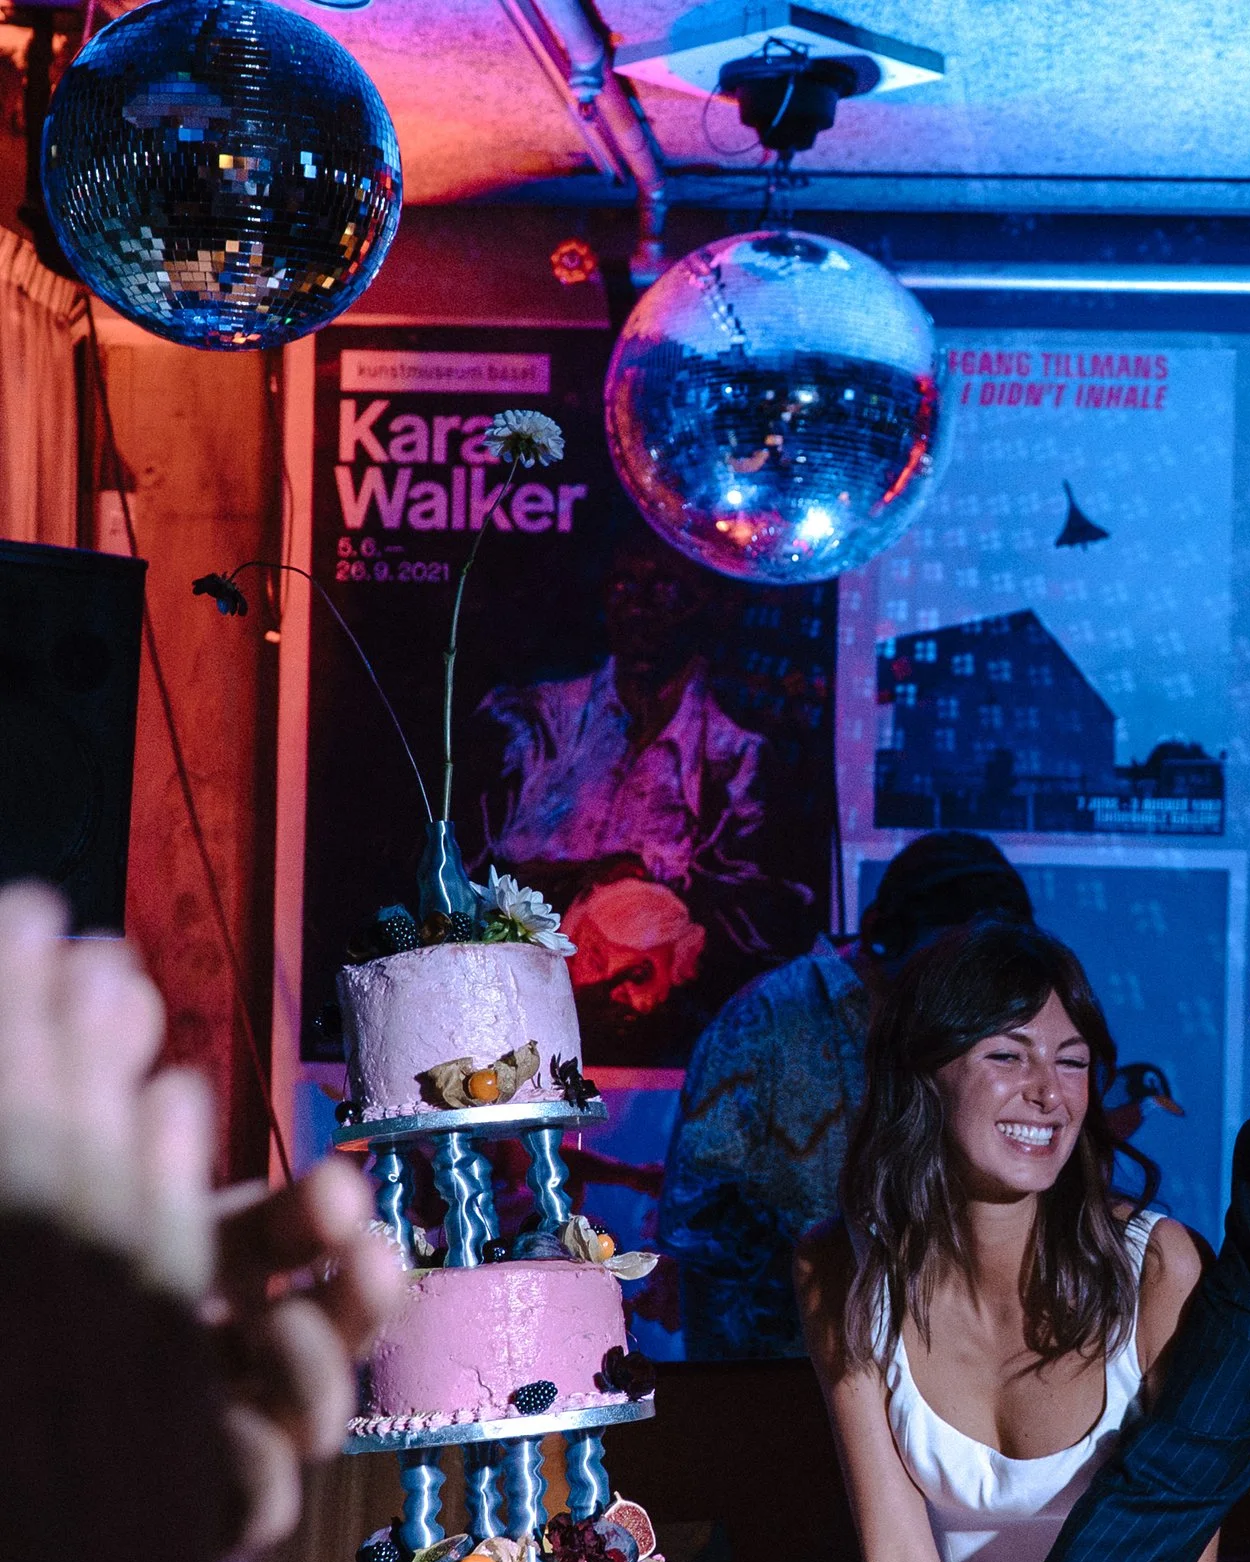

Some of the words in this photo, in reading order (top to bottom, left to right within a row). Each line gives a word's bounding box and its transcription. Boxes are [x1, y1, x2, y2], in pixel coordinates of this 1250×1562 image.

[1041, 352, 1169, 380] TILLMANS
[961, 382, 971, 405] I
[979, 382, 1067, 408] DIDN'T
[1075, 384, 1169, 411] INHALE
[339, 399, 501, 465] Kara
[334, 465, 588, 533] Walker
